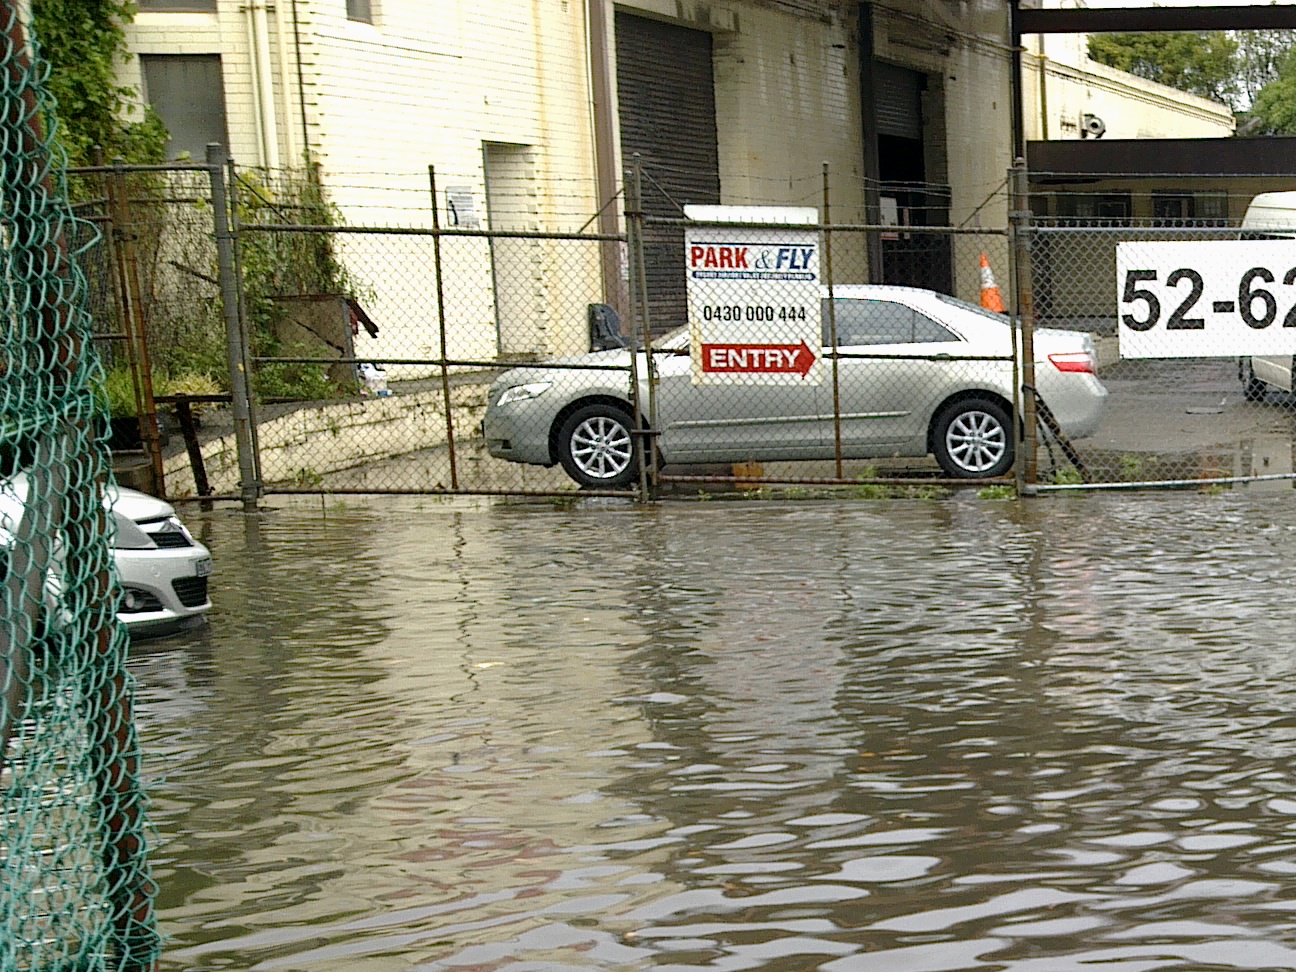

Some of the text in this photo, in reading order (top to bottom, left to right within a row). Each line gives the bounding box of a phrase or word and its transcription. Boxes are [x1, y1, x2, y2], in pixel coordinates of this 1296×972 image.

[690, 246, 814, 269] PARK & FLY
[703, 305, 806, 321] 0430 000 444
[710, 349, 801, 368] ENTRY
